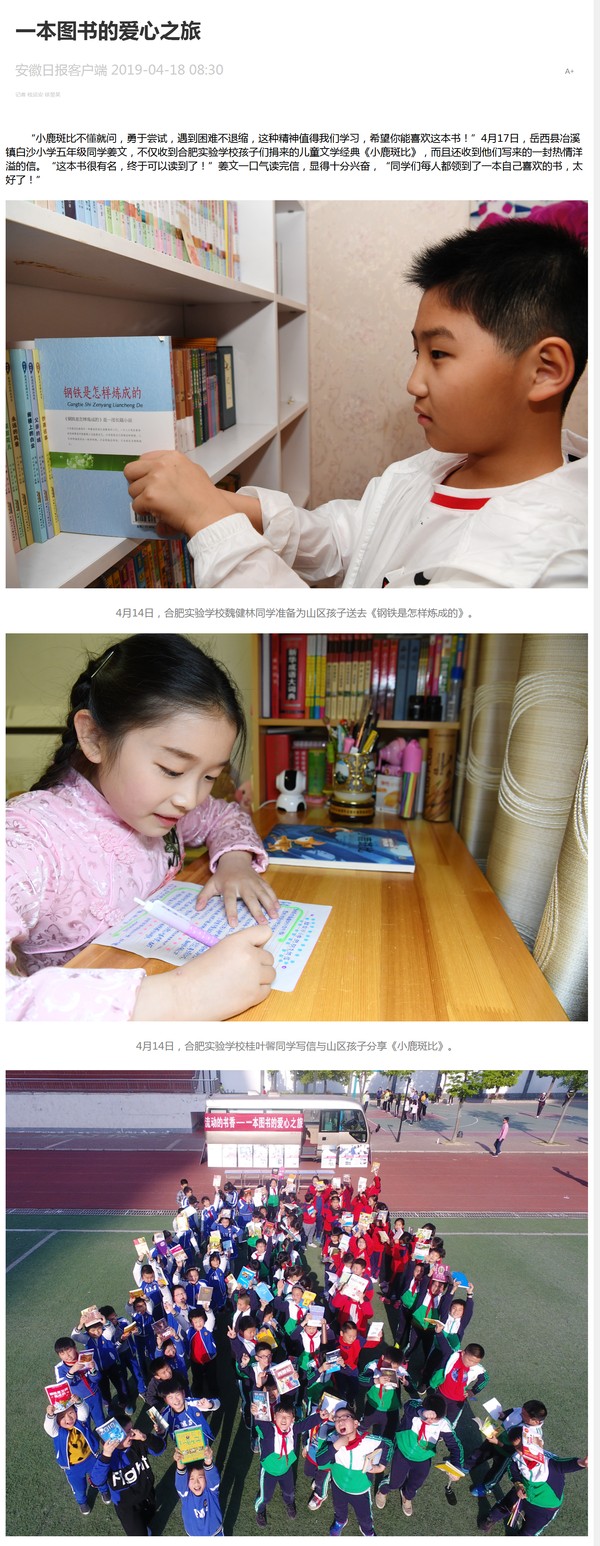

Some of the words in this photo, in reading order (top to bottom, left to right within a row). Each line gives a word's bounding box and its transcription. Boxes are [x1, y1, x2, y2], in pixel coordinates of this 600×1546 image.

[63, 385, 142, 400] 钢铁是怎样炼成的
[112, 1456, 150, 1487] Fight
